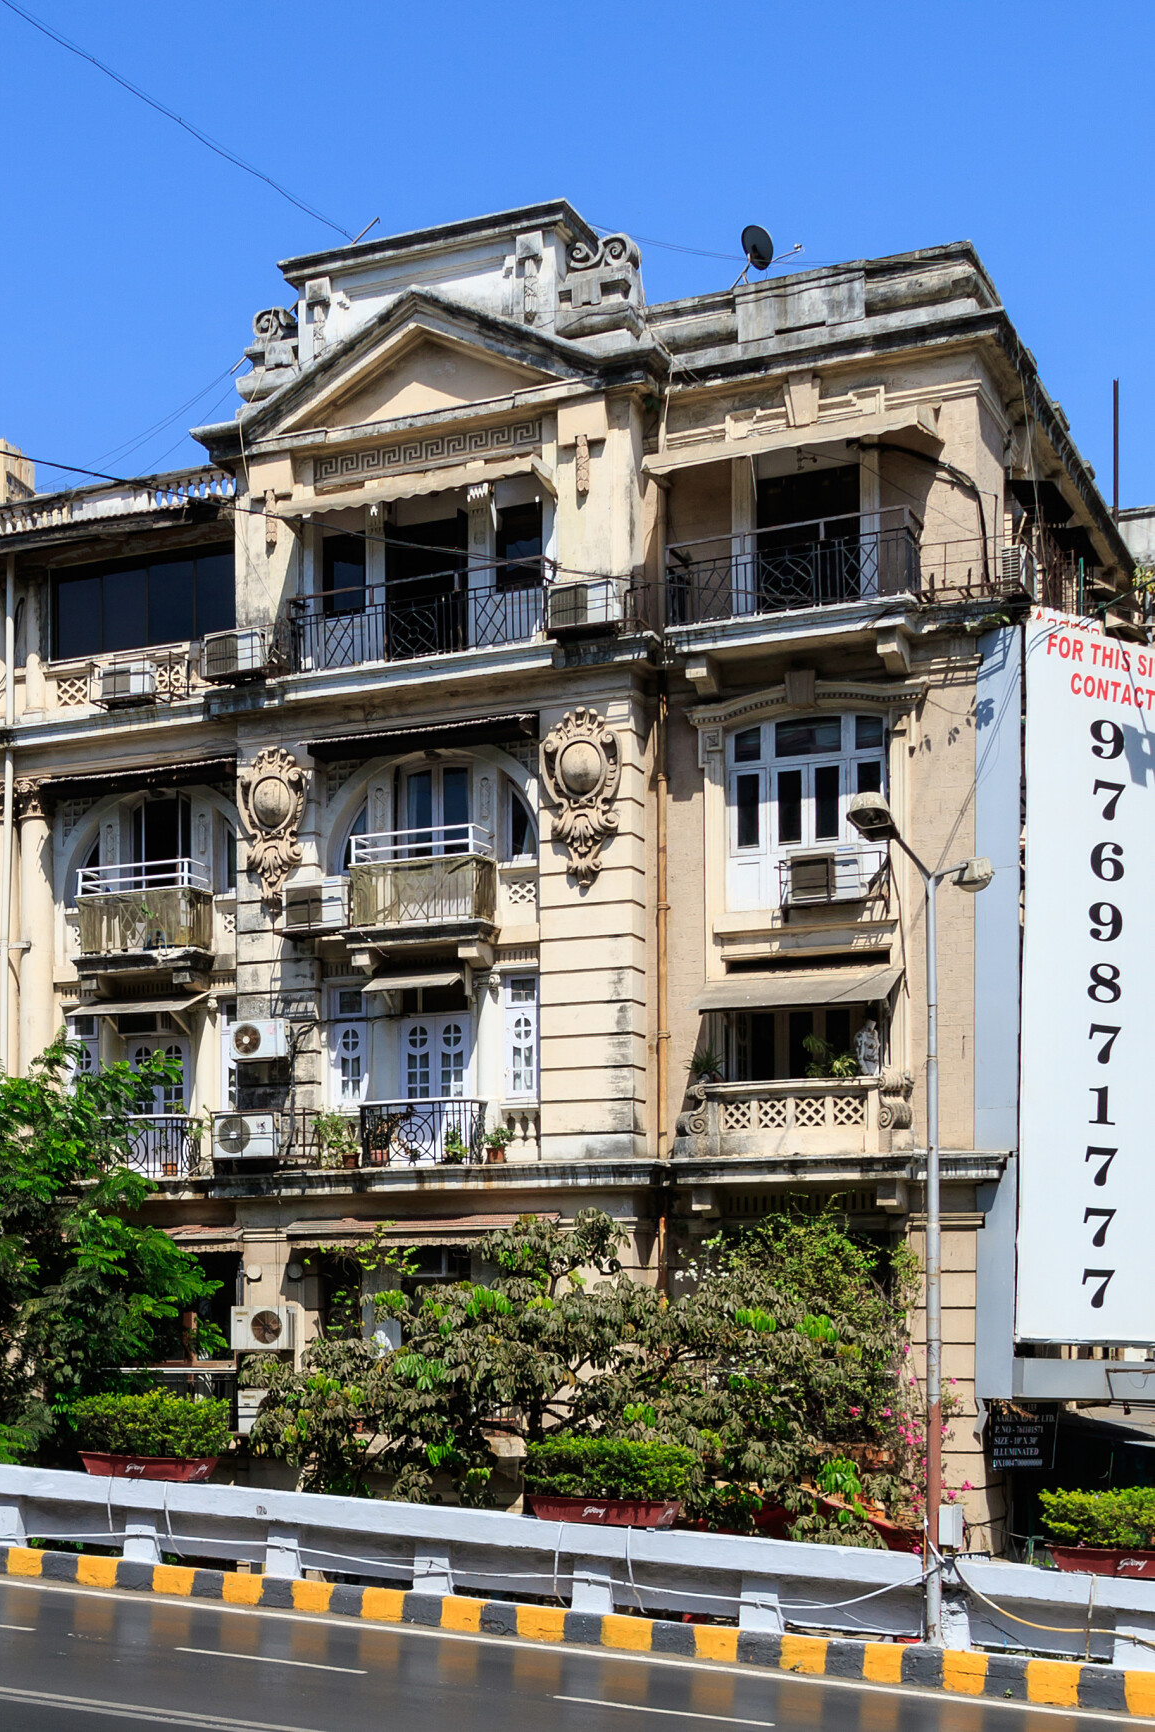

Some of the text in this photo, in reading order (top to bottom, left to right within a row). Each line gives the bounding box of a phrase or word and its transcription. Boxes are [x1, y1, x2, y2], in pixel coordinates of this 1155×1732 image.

[1046, 634, 1155, 678] FOR THIS SI
[1070, 672, 1155, 711] CONTACT
[1082, 719, 1126, 1309] 9769871777
[993, 1436, 1009, 1445] SIZE
[993, 1447, 1040, 1457] ILLUMINATED
